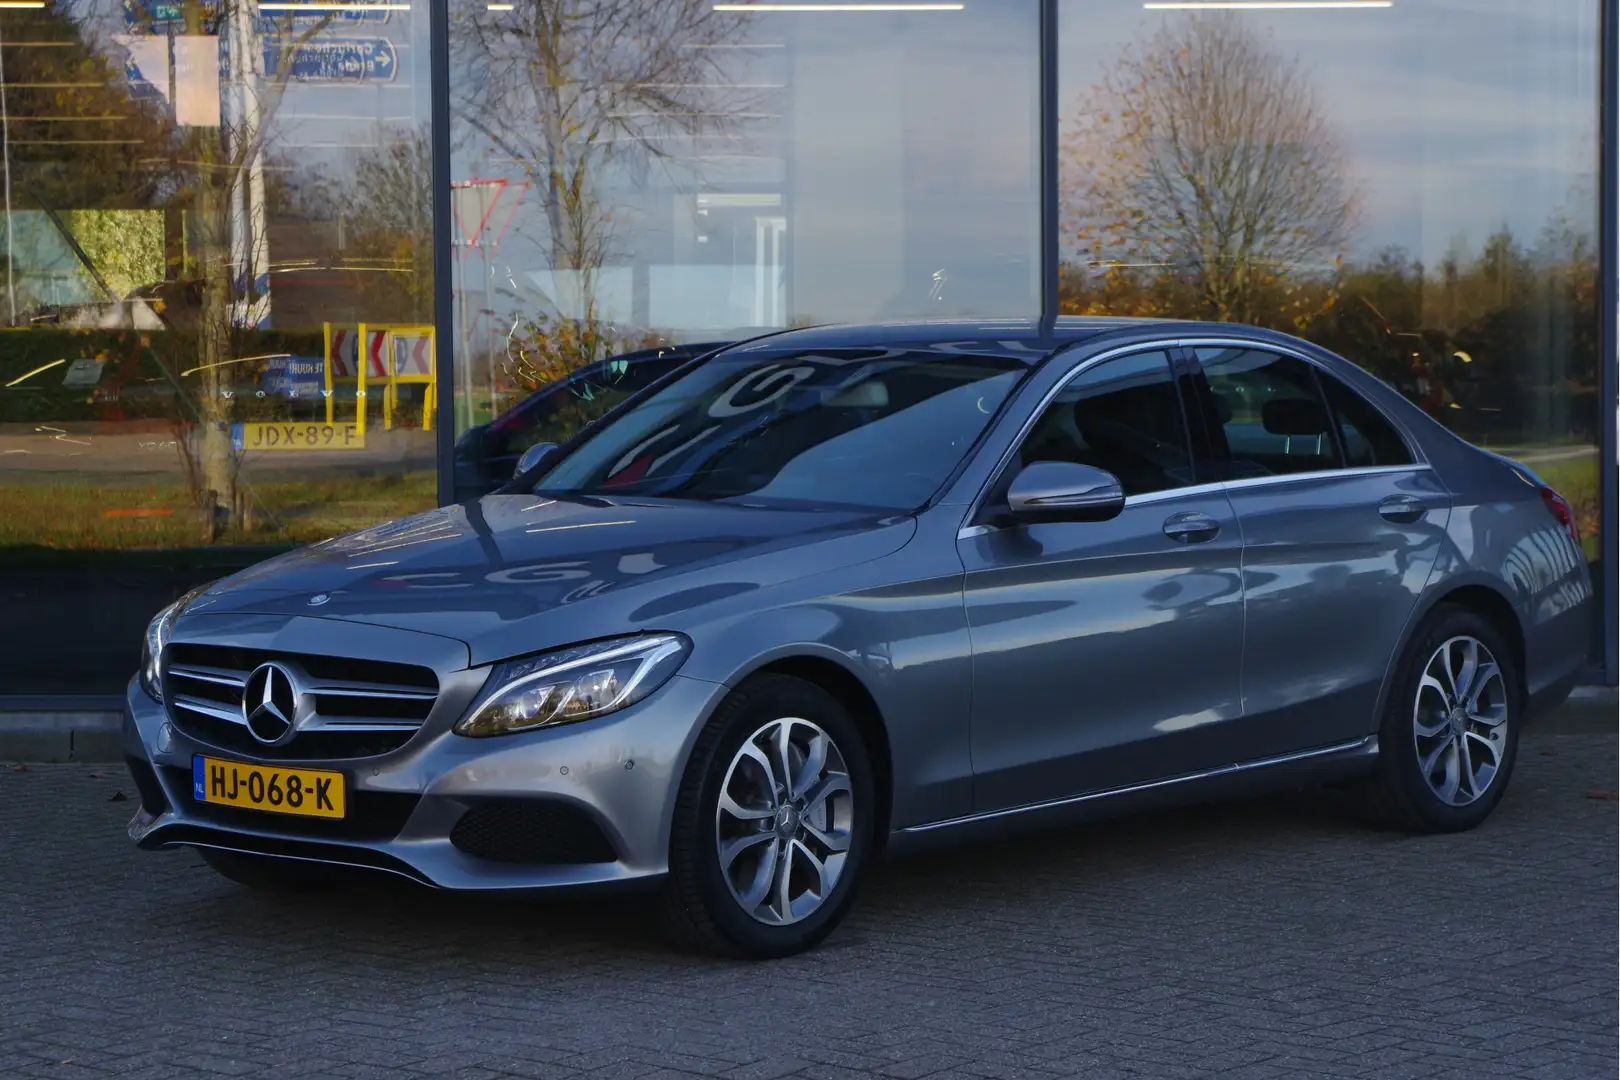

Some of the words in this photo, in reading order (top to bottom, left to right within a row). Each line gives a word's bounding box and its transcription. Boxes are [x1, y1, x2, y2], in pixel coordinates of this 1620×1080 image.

[252, 425, 357, 446] JDX-89-F
[195, 782, 204, 793] NL
[211, 765, 334, 811] HJ-068-K
